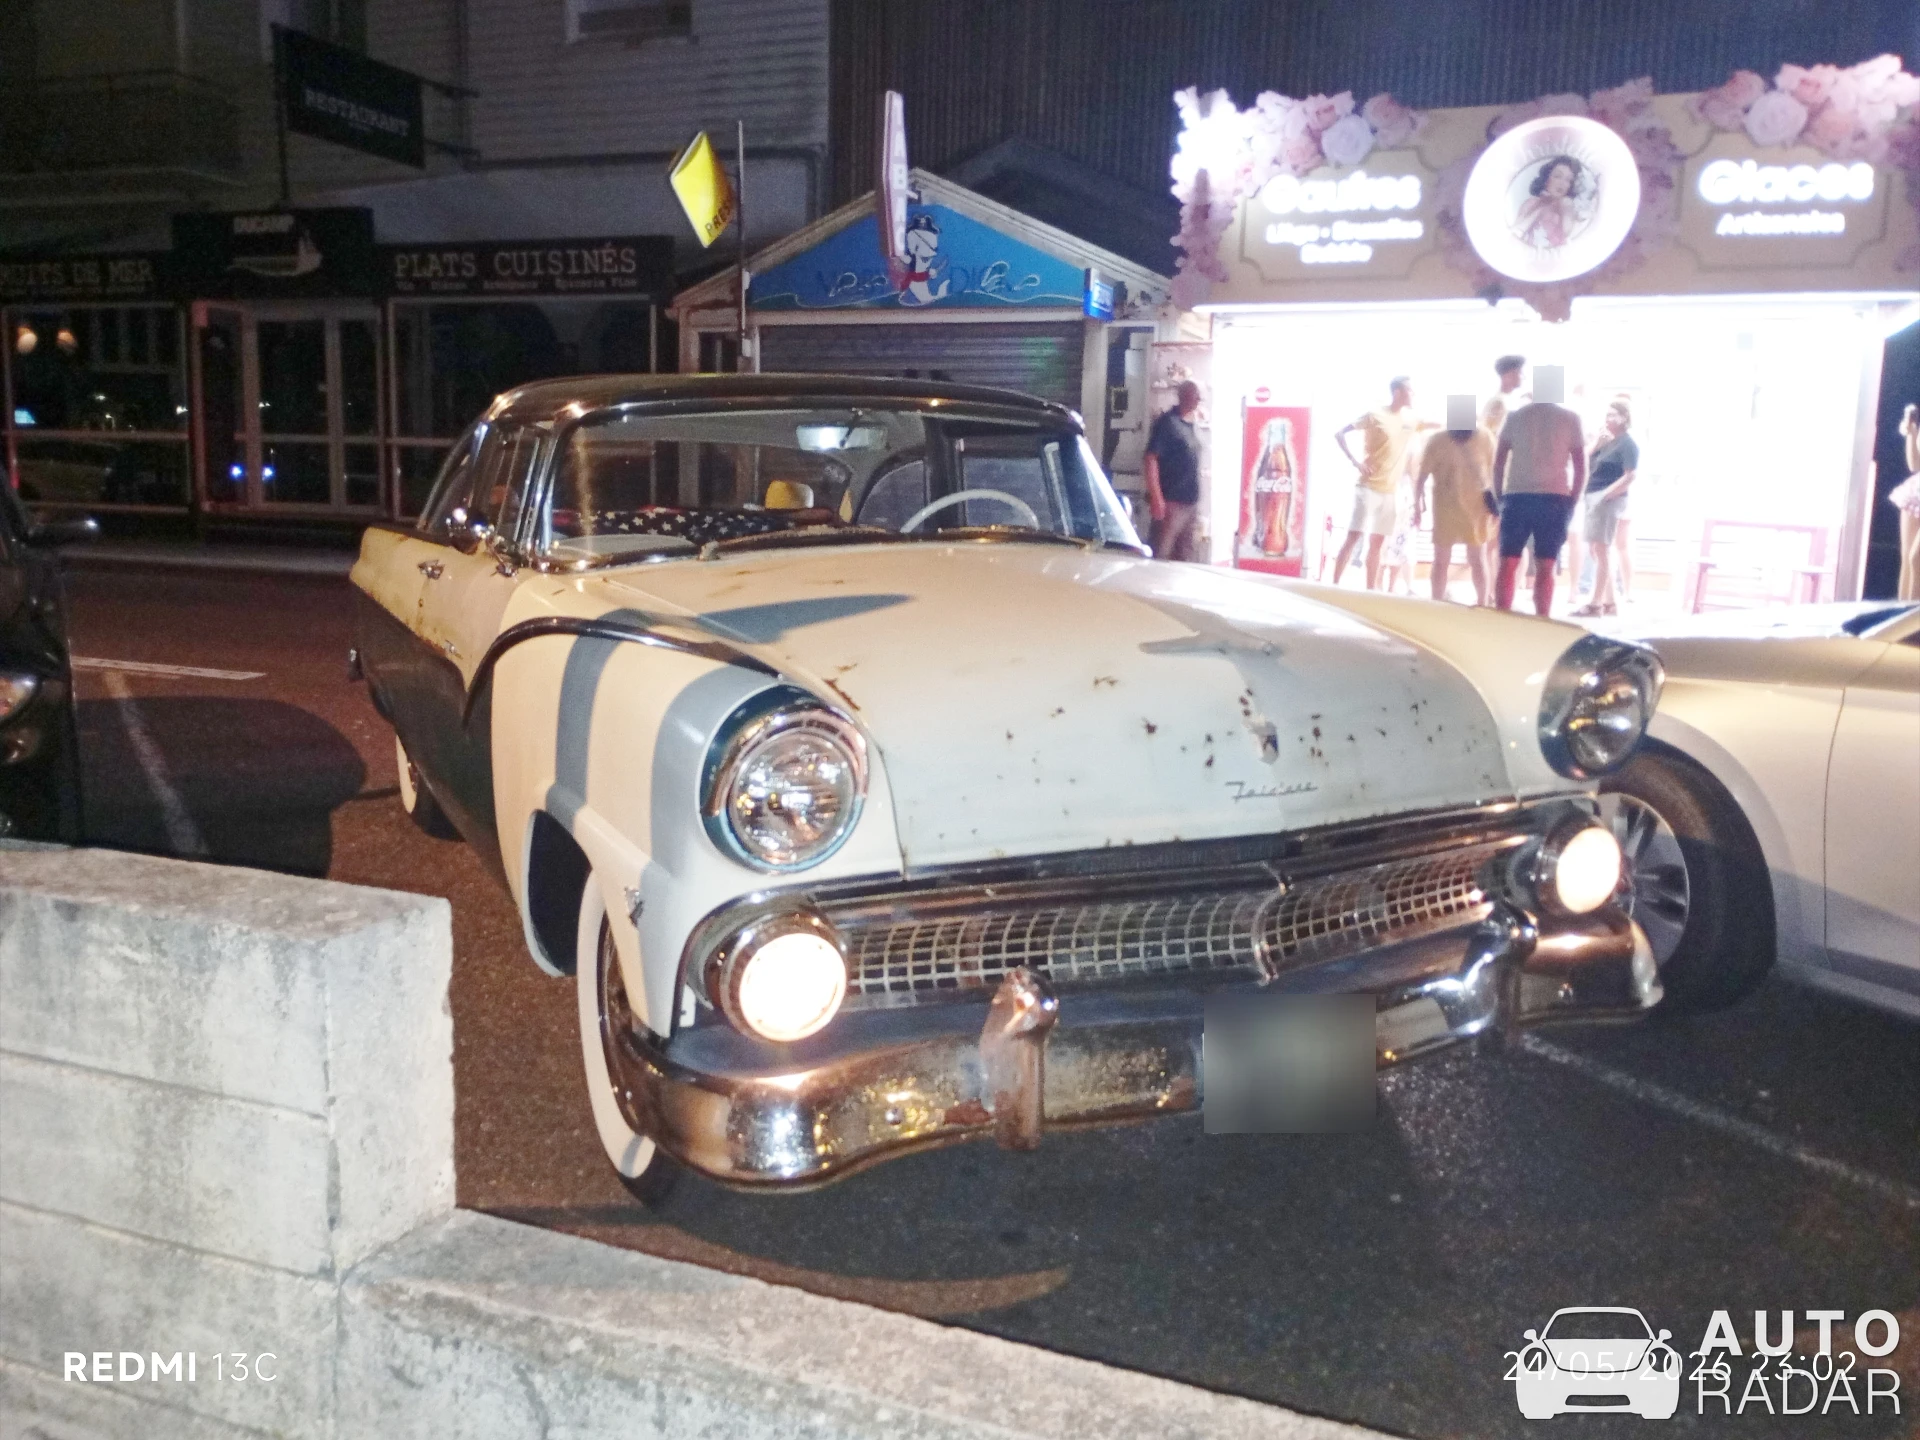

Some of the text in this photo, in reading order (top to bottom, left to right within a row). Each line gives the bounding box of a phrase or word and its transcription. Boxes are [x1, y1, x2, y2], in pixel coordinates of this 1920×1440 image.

[305, 88, 409, 137] RESTAURANT
[1263, 170, 1422, 214] Gaufres
[1698, 159, 1875, 204] Glaces
[73, 261, 102, 285] DE
[108, 260, 153, 284] MER
[394, 243, 637, 278] PLATS CUISINÉS
